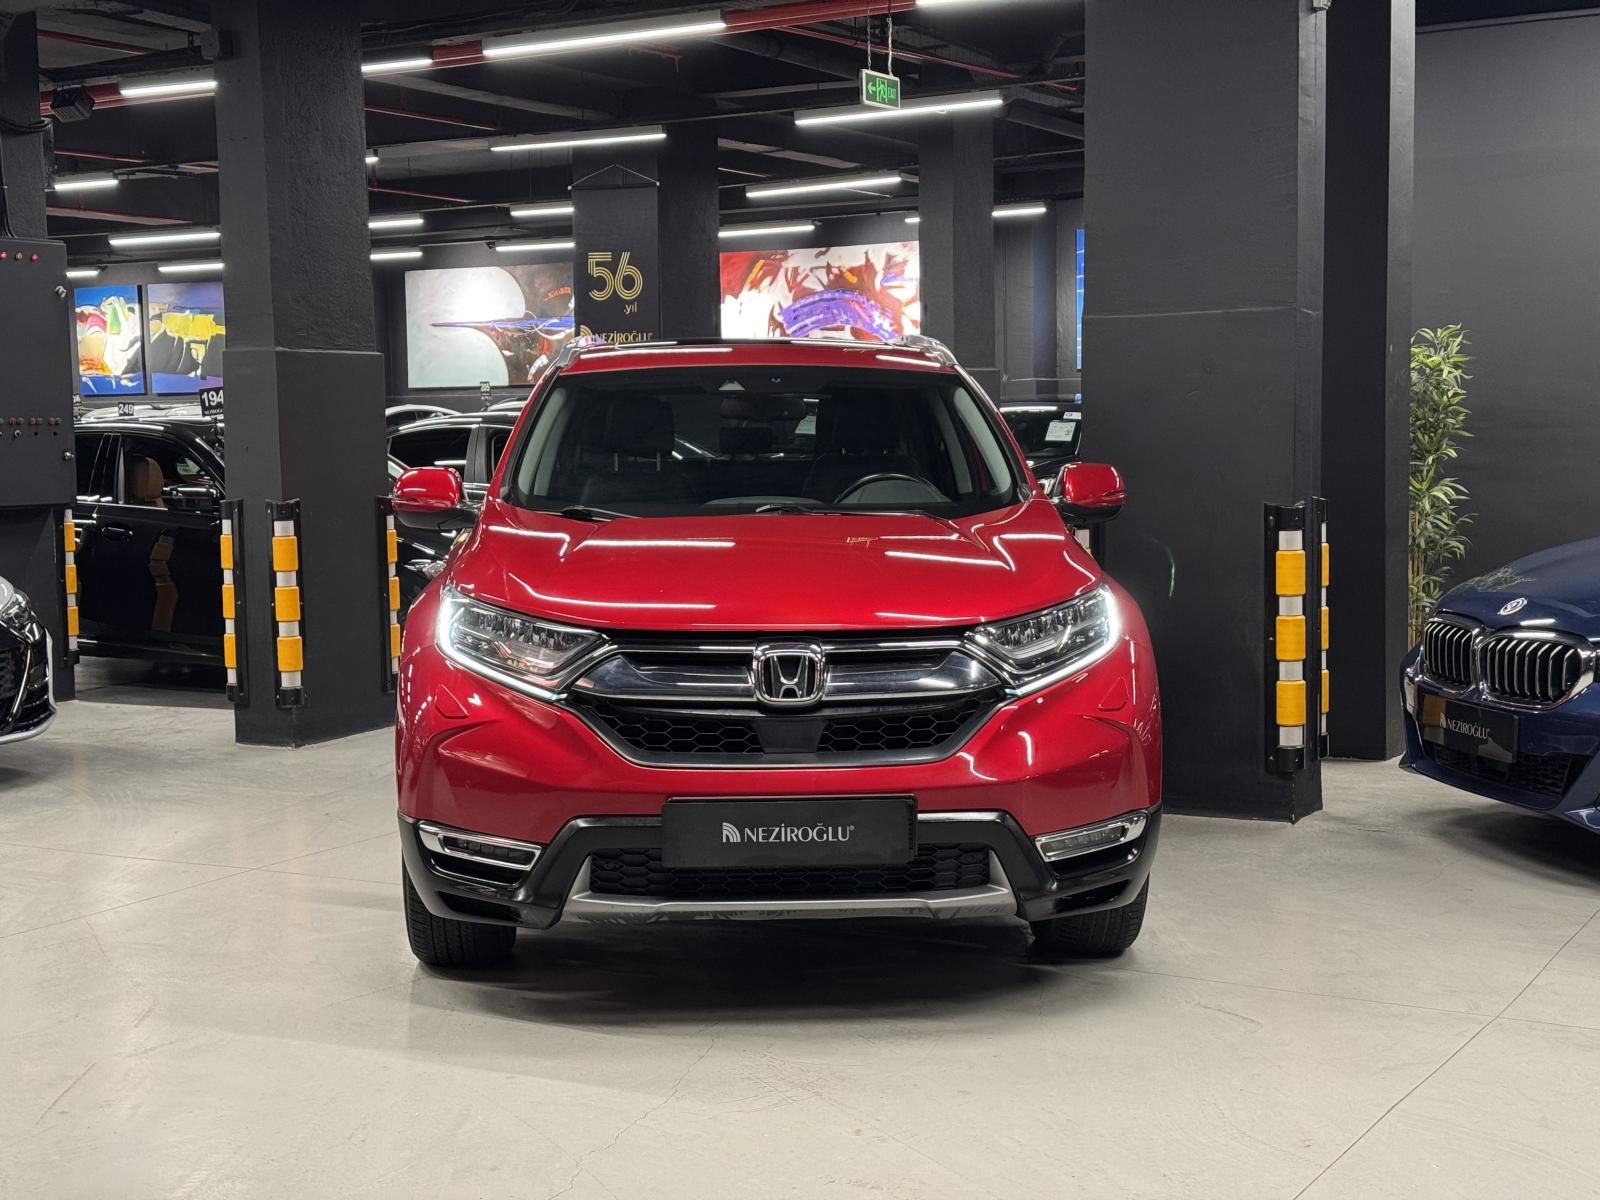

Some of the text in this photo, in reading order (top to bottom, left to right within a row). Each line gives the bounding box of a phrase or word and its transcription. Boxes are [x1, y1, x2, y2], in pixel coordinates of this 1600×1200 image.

[588, 252, 643, 300] 56
[202, 390, 224, 407] 194
[118, 403, 134, 415] 249
